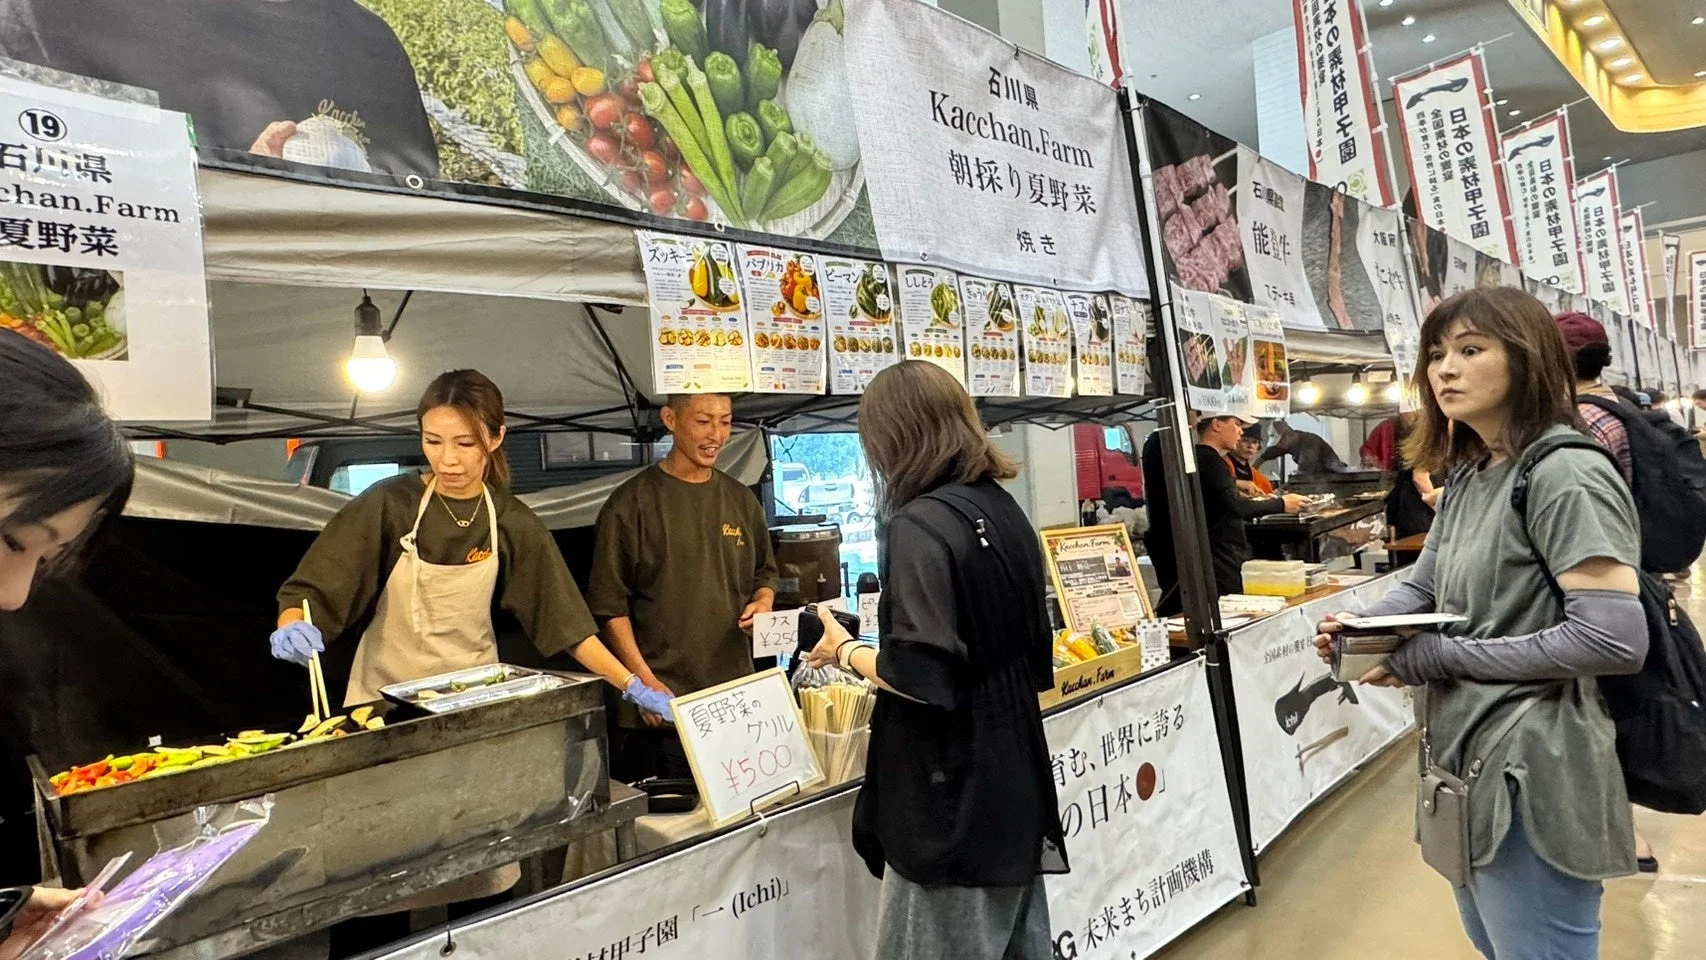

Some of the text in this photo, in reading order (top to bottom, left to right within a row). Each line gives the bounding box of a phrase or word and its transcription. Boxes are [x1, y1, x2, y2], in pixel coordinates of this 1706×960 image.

[988, 66, 1039, 111] 石川県
[929, 90, 1094, 169] Kacchan.Farm
[0, 142, 113, 184] 石川県
[948, 149, 1097, 215] 朝採り夏野菜
[0, 216, 119, 257] 夏野菜
[1016, 227, 1057, 256] 焼き
[825, 268, 861, 285] ピーマン
[905, 276, 934, 290] ししとう
[770, 615, 791, 627] ナス
[688, 690, 762, 739] 夏野菜の
[747, 713, 794, 744] グリル
[721, 744, 793, 795] ¥500
[1082, 848, 1214, 952] 未来まち計画機構
